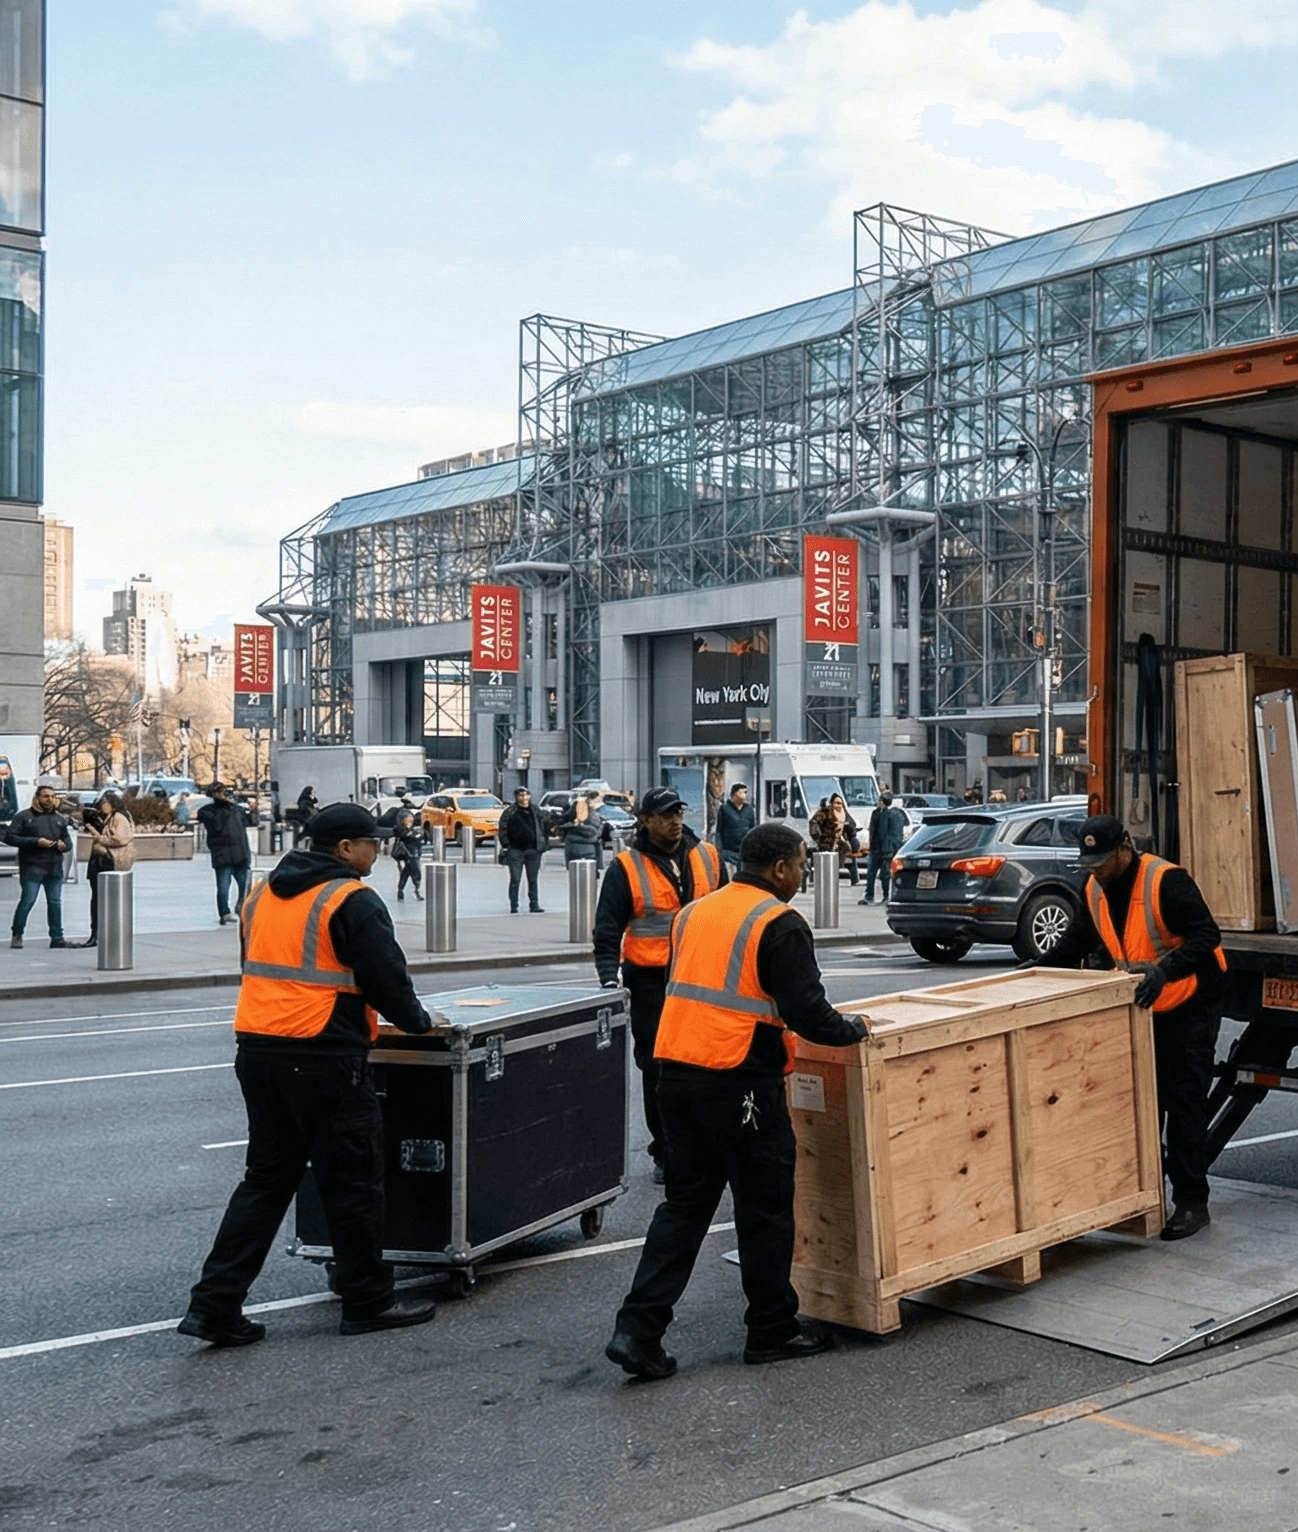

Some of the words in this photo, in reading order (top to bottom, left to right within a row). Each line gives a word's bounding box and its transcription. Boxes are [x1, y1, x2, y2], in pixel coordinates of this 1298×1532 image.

[814, 550, 831, 628] JAVITS
[837, 554, 851, 629] CENTER
[240, 632, 254, 684] JAVITS
[480, 596, 496, 660] JAVITS
[500, 598, 513, 660] CENTER
[488, 671, 503, 685] 21
[696, 687, 720, 704] New
